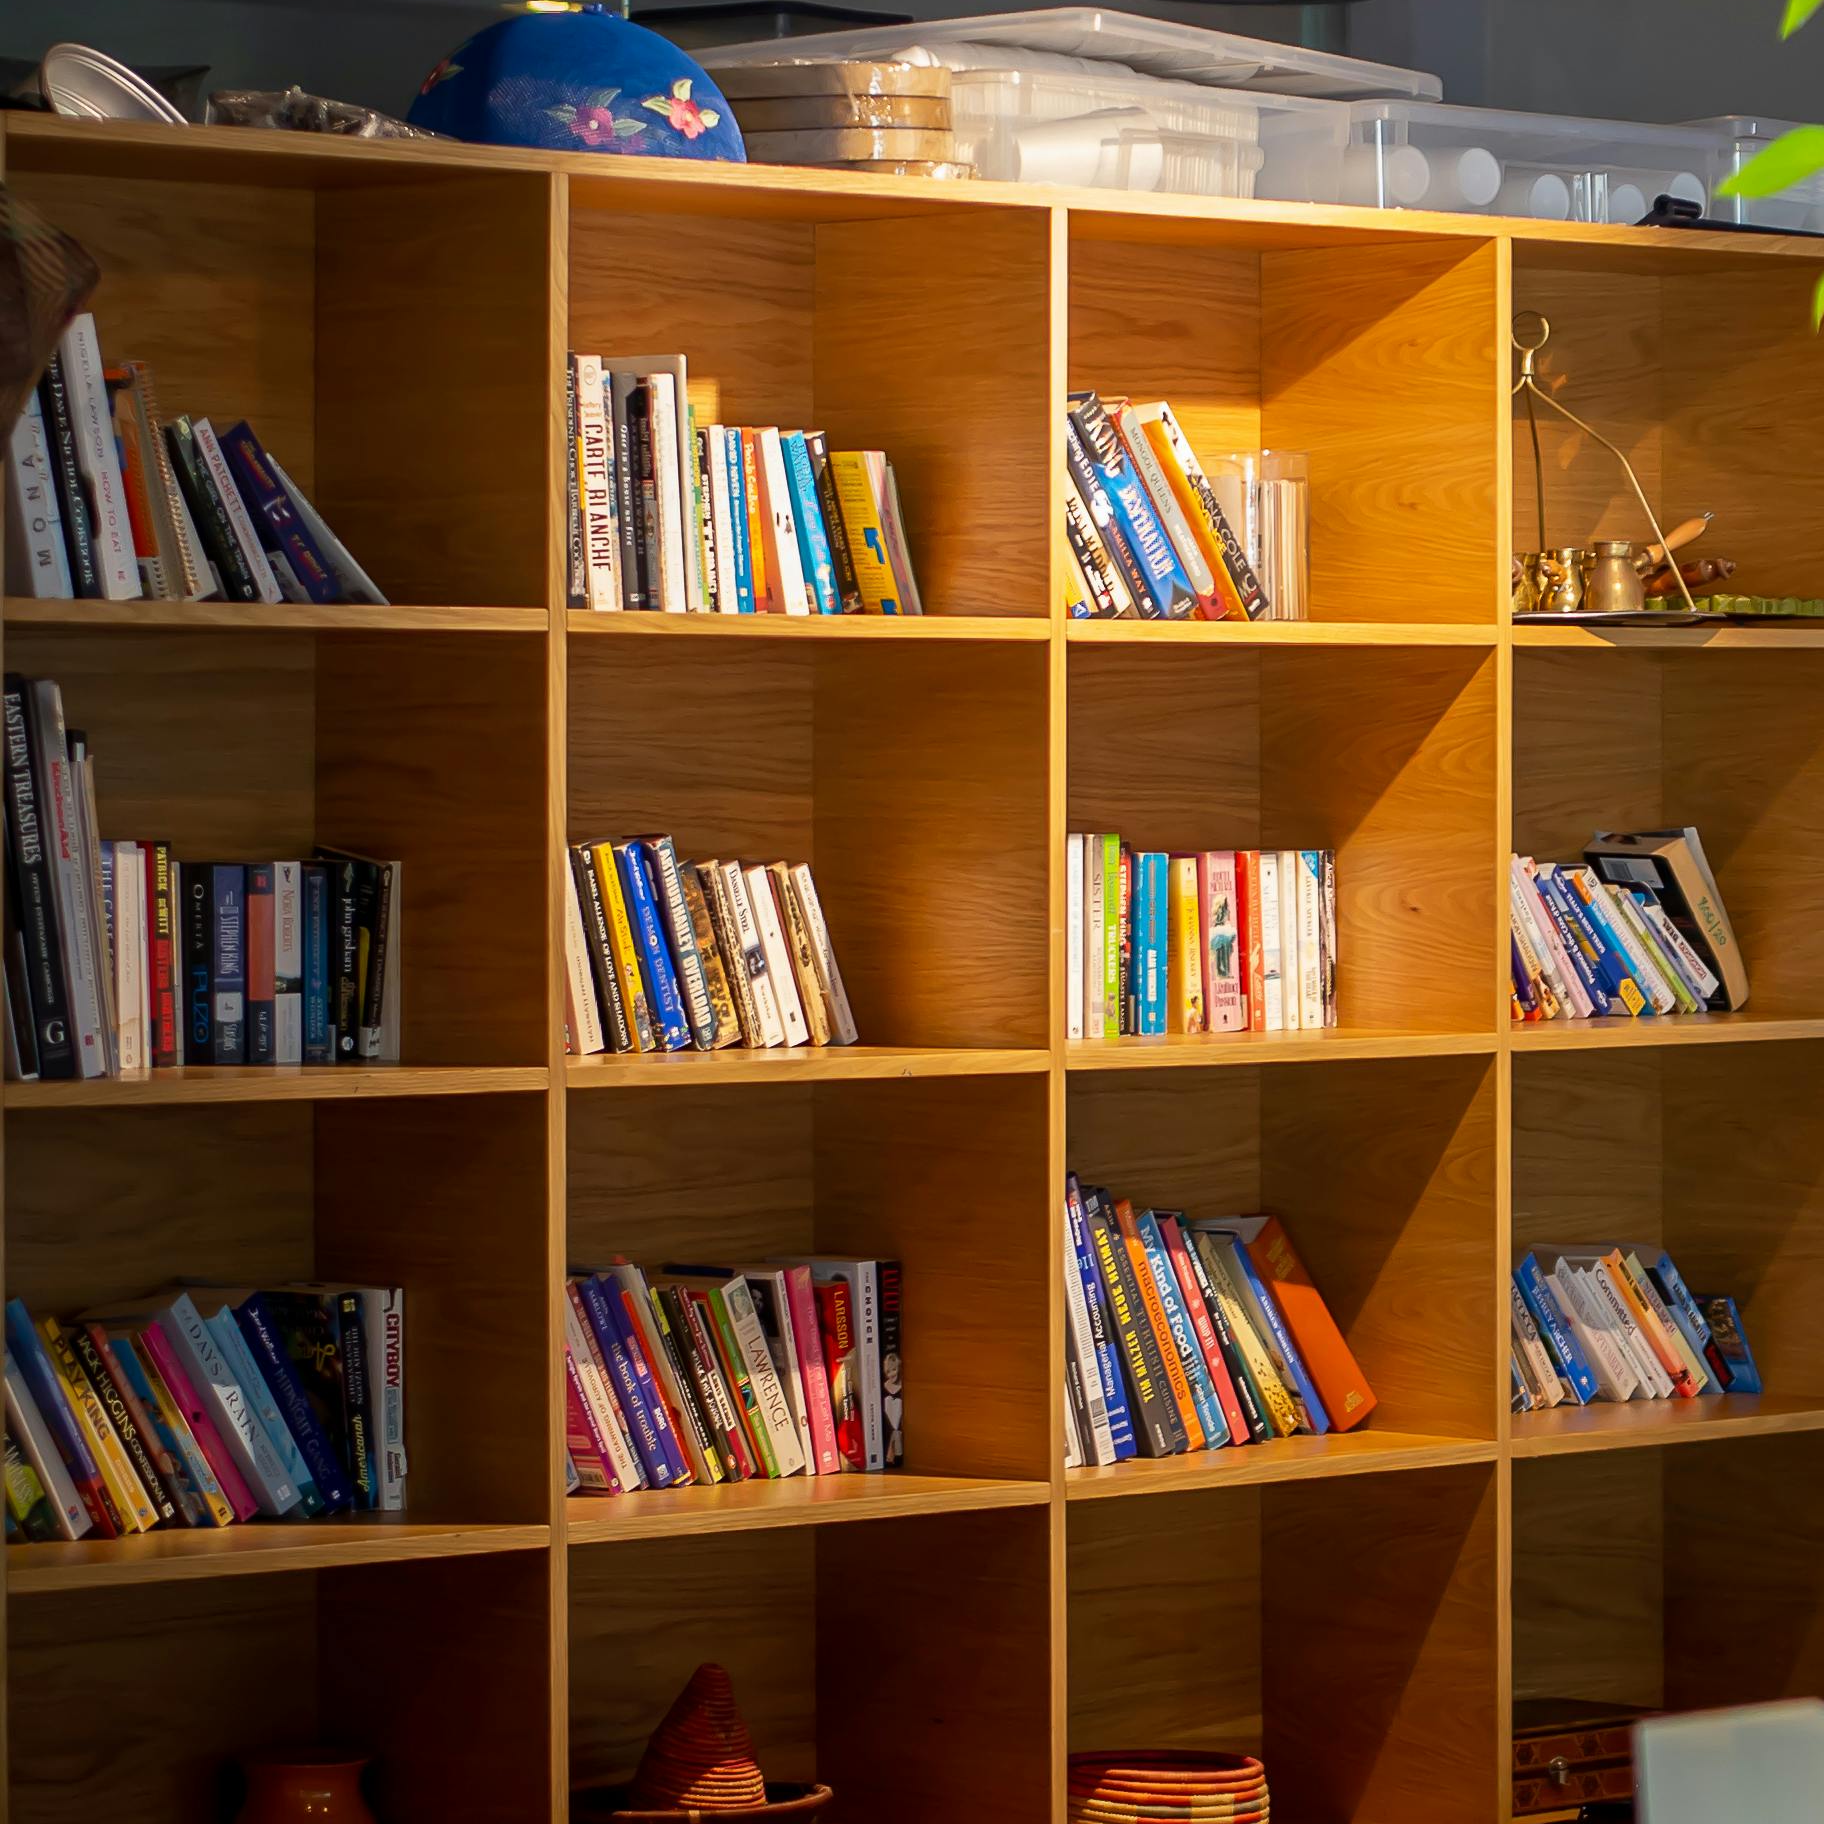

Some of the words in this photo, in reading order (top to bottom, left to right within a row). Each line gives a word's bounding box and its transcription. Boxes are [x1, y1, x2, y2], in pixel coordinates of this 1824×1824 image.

[199, 427, 215, 453] ANN
[210, 454, 240, 513] PATCHETT
[727, 430, 736, 463] DAVID
[1084, 416, 1129, 479] KING
[1129, 426, 1154, 471] MONGOL
[1150, 472, 1173, 514] QUEENS
[100, 470, 112, 503] HOW
[107, 510, 116, 526] TO
[111, 531, 121, 552] EAT
[1079, 459, 1100, 492] EDIE
[1130, 568, 1145, 594] WAY
[233, 549, 249, 579] TRAIN
[1218, 527, 1247, 572] COLE
[4, 692, 27, 766] EASTERN
[14, 768, 40, 865] TREASURES
[156, 846, 166, 891] PATRICK
[587, 869, 598, 897] ISABEL
[342, 898, 354, 923] john
[593, 900, 607, 941] ALLENDE
[658, 848, 682, 907] ARTHUR
[671, 904, 693, 952] HAILEY
[728, 868, 744, 907] DANIELLE
[738, 908, 751, 934] STEEL
[1092, 873, 1100, 928] SISTER
[221, 916, 237, 952] STEPHEN
[341, 926, 355, 972] grisham
[602, 943, 609, 955] OF
[642, 905, 660, 955] DEMON
[654, 957, 673, 1012] DENTIST
[1107, 924, 1115, 983] TRUCKERS
[1590, 932, 1605, 954] TRIPS
[221, 952, 236, 974] KING
[604, 956, 614, 979] LOVE
[193, 971, 207, 1043] PUZO
[610, 981, 619, 1001] AND
[685, 953, 711, 1027] OVERLOAD
[1094, 1227, 1118, 1284] HEIMAT
[1139, 1224, 1157, 1253] My
[1149, 1253, 1172, 1296] Kind
[1163, 1295, 1178, 1314] of
[832, 1290, 849, 1348] LARSSON
[1086, 1281, 1104, 1339] Accounting
[1110, 1283, 1131, 1324] NEUE
[1531, 1286, 1554, 1323] JEFFREY
[1549, 1322, 1575, 1364] ARCHER
[1594, 1266, 1637, 1337] Committed
[186, 1324, 225, 1377] DAYS
[386, 1313, 398, 1386] CITYBOY
[610, 1342, 624, 1361] the
[1116, 1247, 1139, 1304] ESSENTIAL
[1135, 1309, 1162, 1377] TURKISH
[1158, 1379, 1177, 1424] CUISINE
[1138, 1259, 1188, 1401] macroeconomics
[1167, 1312, 1195, 1357] Food
[77, 1333, 104, 1373] JACK
[95, 1371, 137, 1441] HIGGINS
[581, 1356, 602, 1401] AUROVILLE
[617, 1361, 637, 1394] book
[747, 1336, 789, 1431] LAWRENCE
[1097, 1339, 1116, 1396] Managerial
[1138, 1378, 1154, 1402] TIM
[1193, 1382, 1206, 1403] John
[223, 1390, 260, 1442] RAIN
[272, 1367, 313, 1436] MIDNIGHT
[305, 1437, 332, 1480] GANG
[599, 1402, 607, 1413] OF
[630, 1393, 642, 1408] of
[353, 1413, 367, 1492] Americanah
[603, 1413, 621, 1452] DAWNING
[635, 1408, 658, 1452] trouble
[128, 1437, 167, 1502] CONFESSIONAL
[617, 1453, 627, 1469] THE
